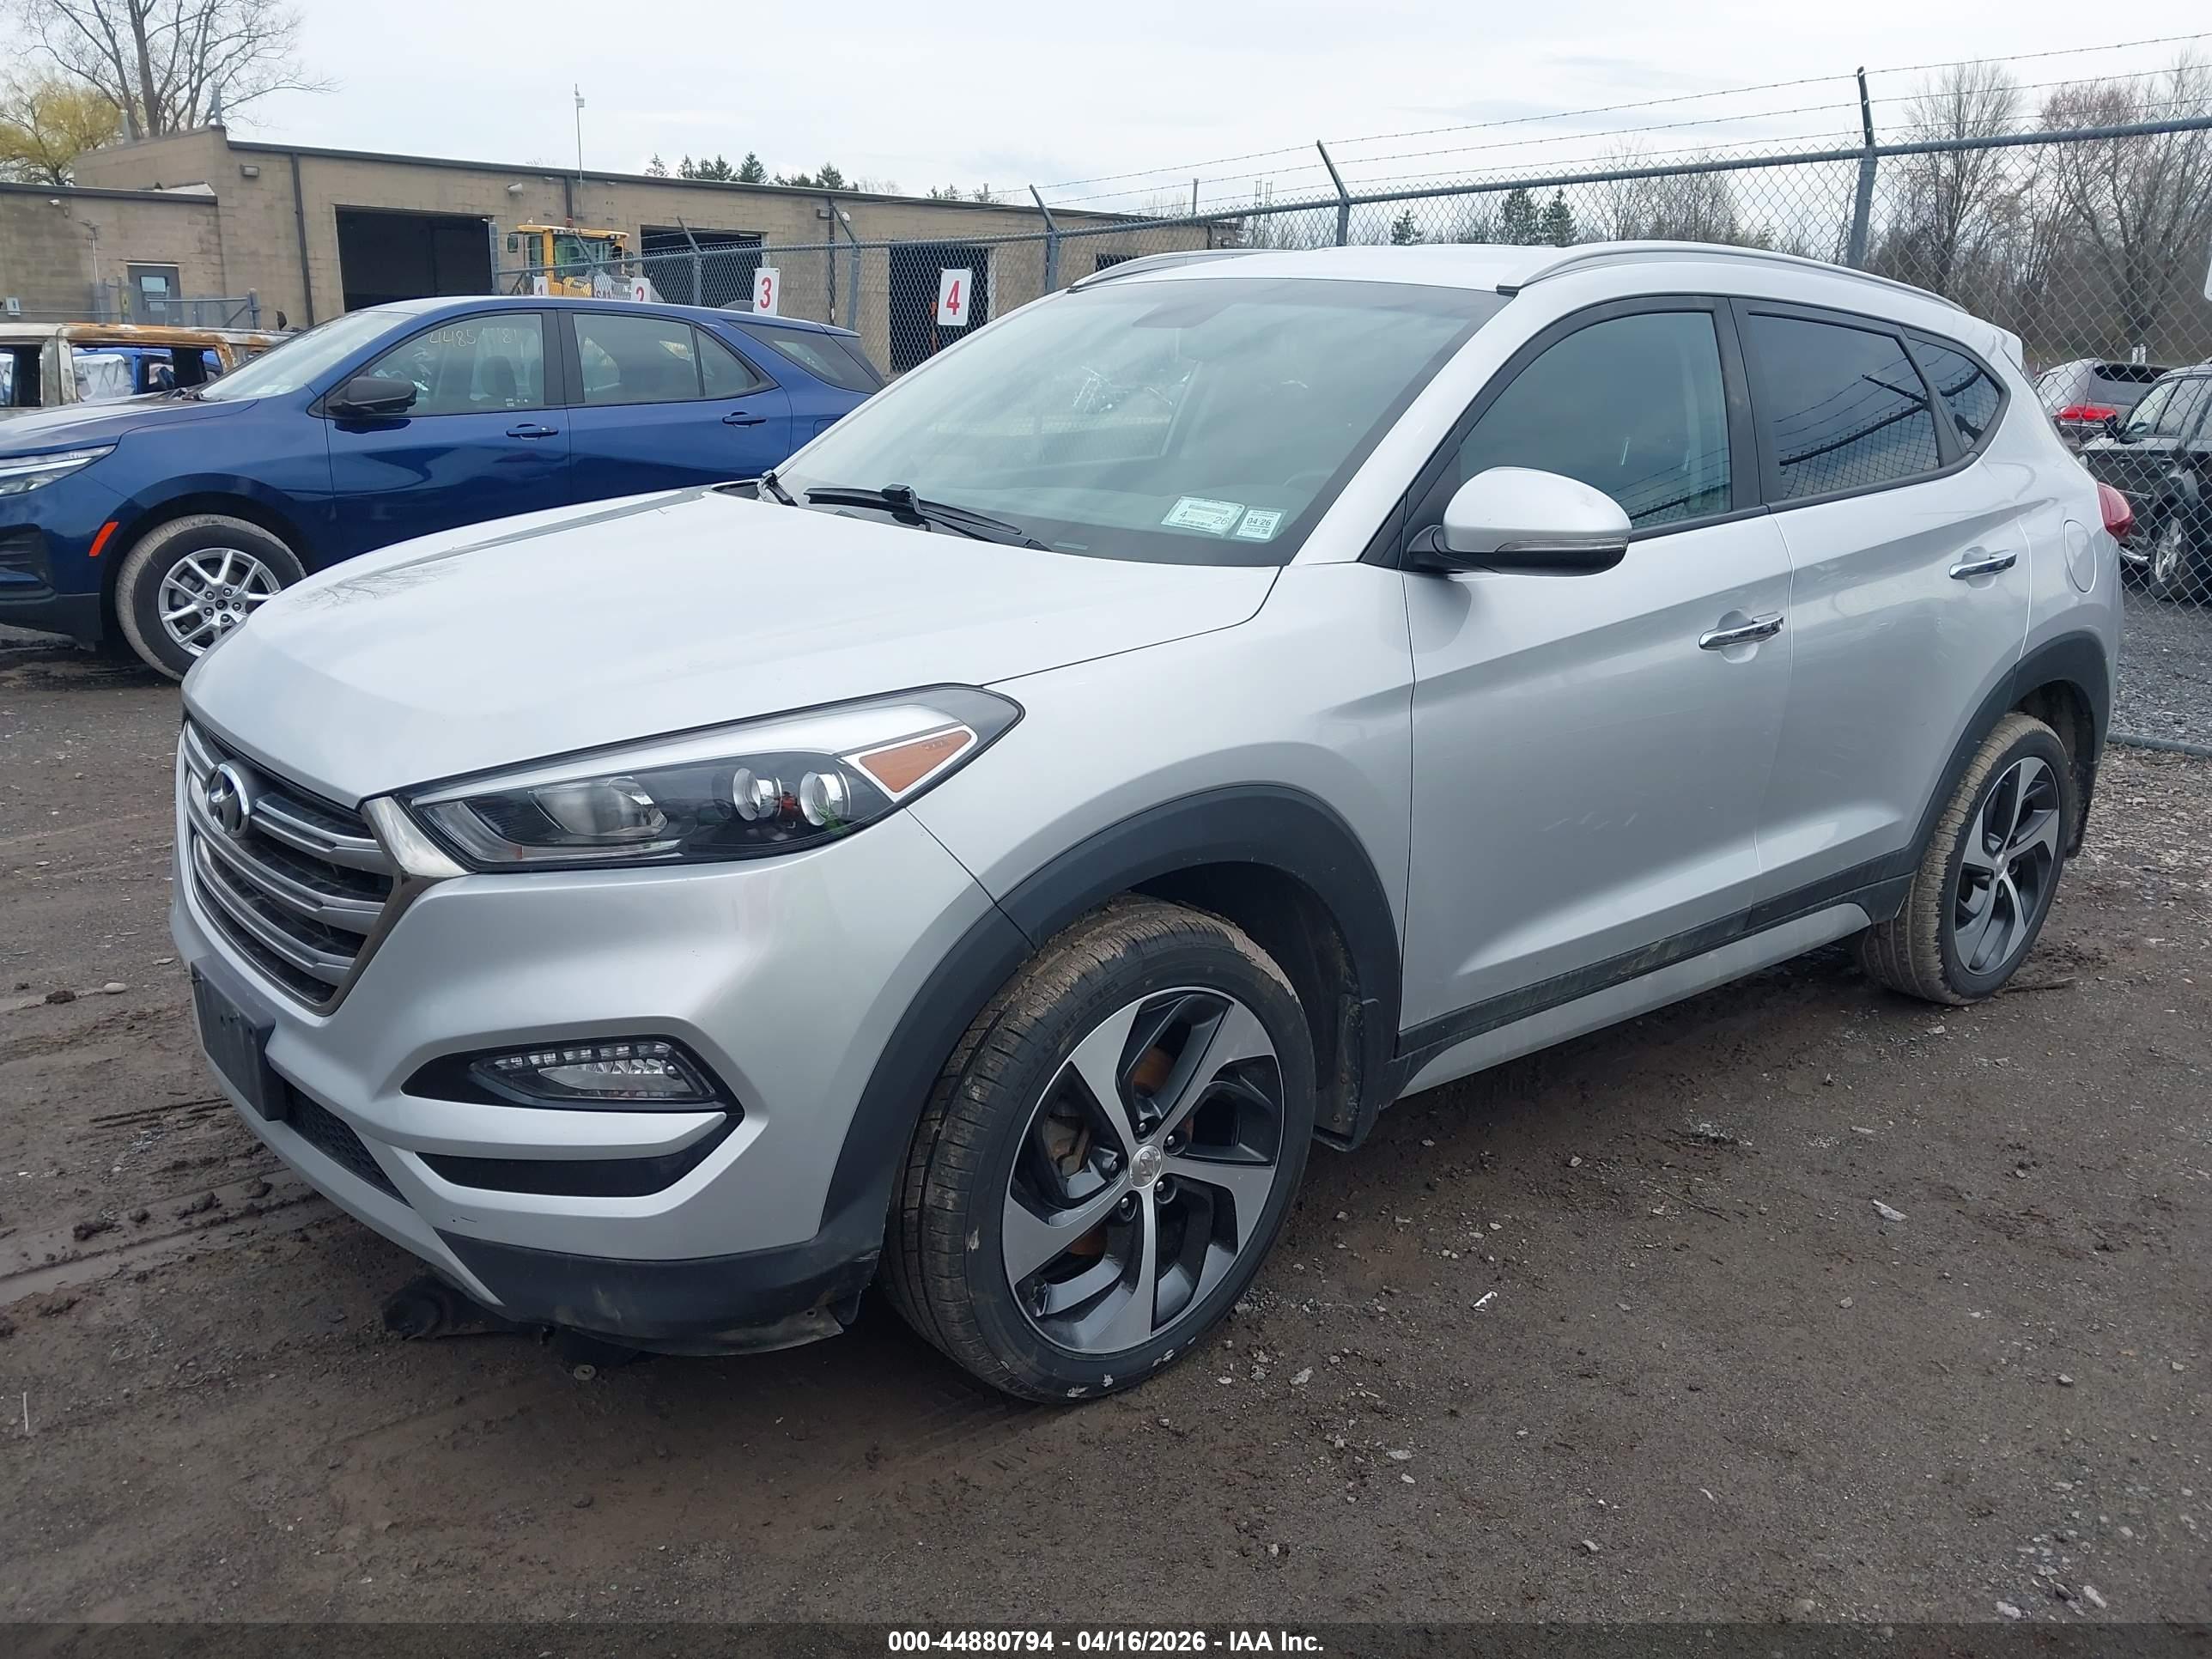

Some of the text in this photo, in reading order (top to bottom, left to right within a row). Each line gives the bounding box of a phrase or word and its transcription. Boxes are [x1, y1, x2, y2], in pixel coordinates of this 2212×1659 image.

[759, 276, 772, 308] 3
[945, 280, 961, 315] 4
[1212, 516, 1230, 525] 26
